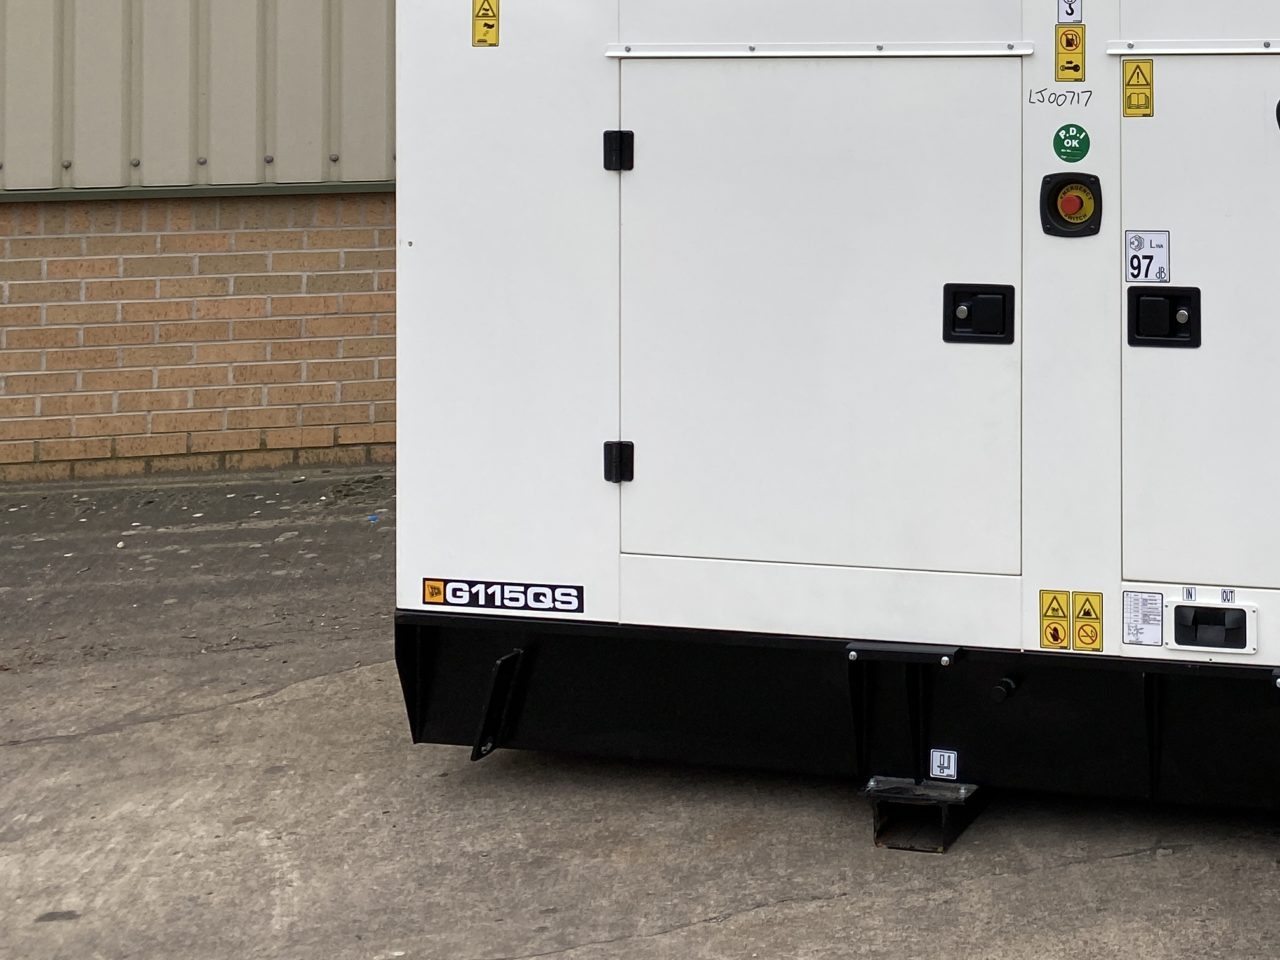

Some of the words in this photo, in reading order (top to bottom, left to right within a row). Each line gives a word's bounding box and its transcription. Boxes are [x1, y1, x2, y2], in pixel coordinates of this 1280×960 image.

[1028, 87, 1093, 108] LJ00717
[1063, 139, 1080, 148] OK
[1130, 254, 1154, 279] 97
[1155, 266, 1167, 280] dB
[445, 582, 579, 610] G115QS
[1185, 588, 1193, 600] IN
[1222, 590, 1234, 602] OUT
